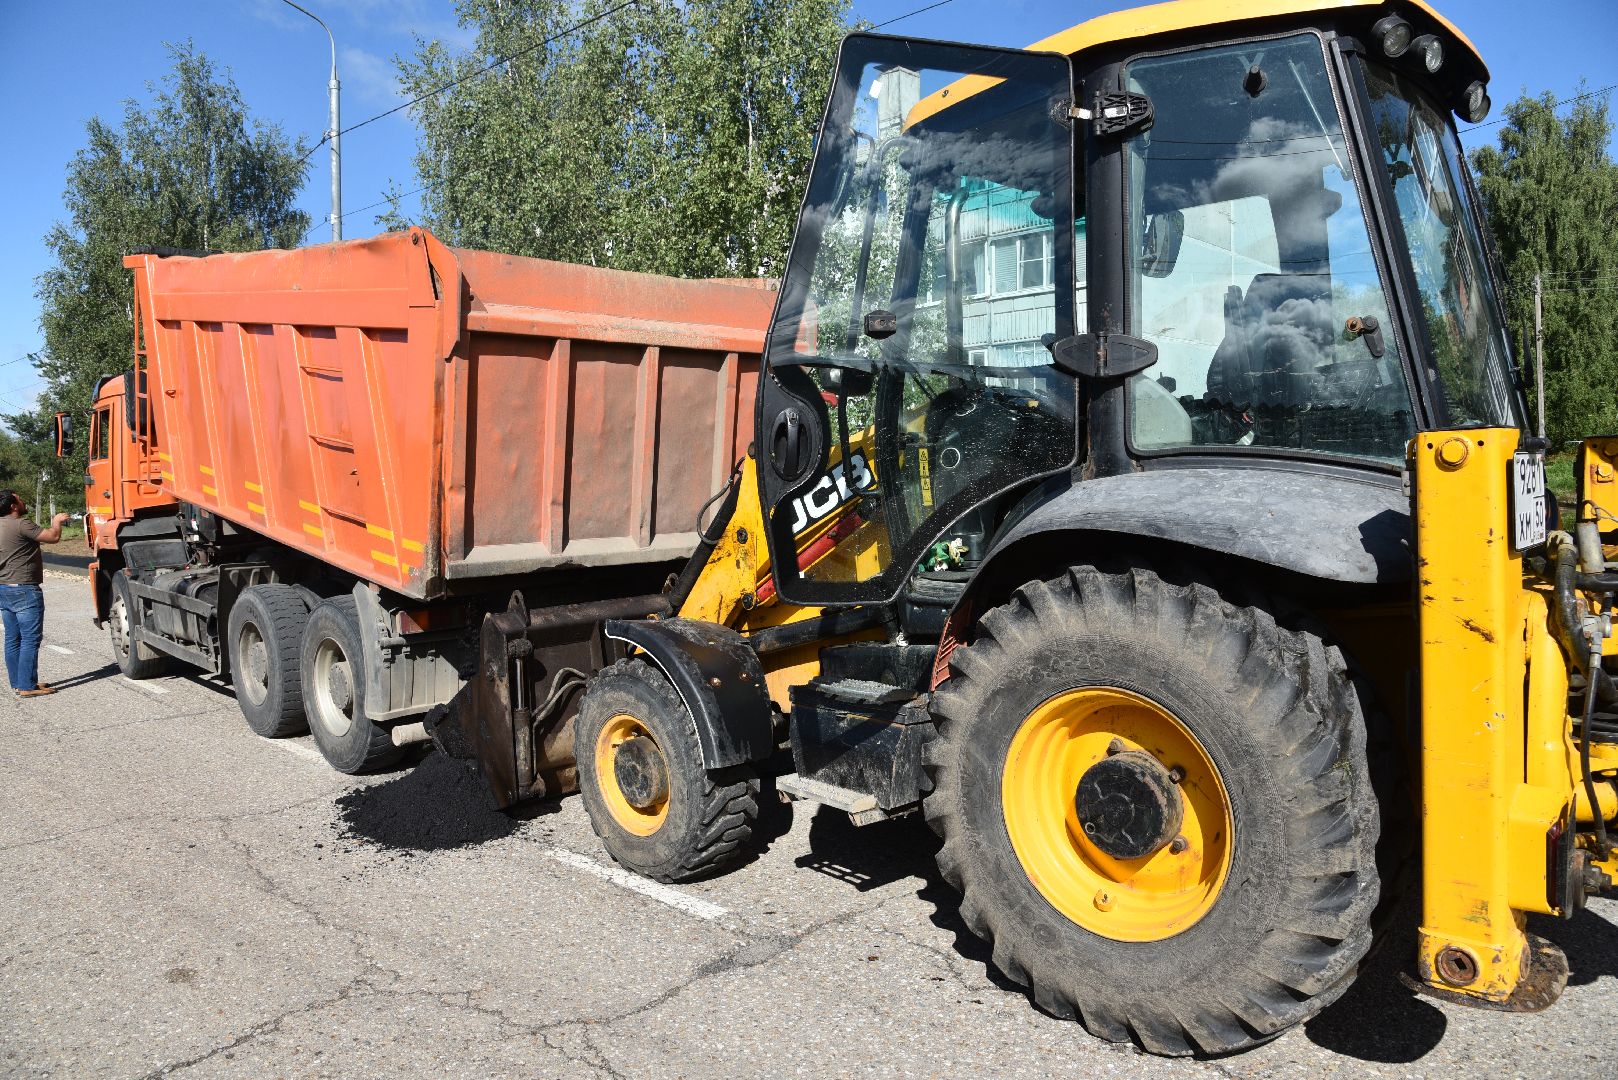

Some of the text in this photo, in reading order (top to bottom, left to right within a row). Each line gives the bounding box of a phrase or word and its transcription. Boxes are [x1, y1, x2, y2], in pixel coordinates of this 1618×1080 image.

[792, 454, 871, 534] JCB
[1520, 458, 1542, 495] 9281
[1535, 501, 1544, 528] 50
